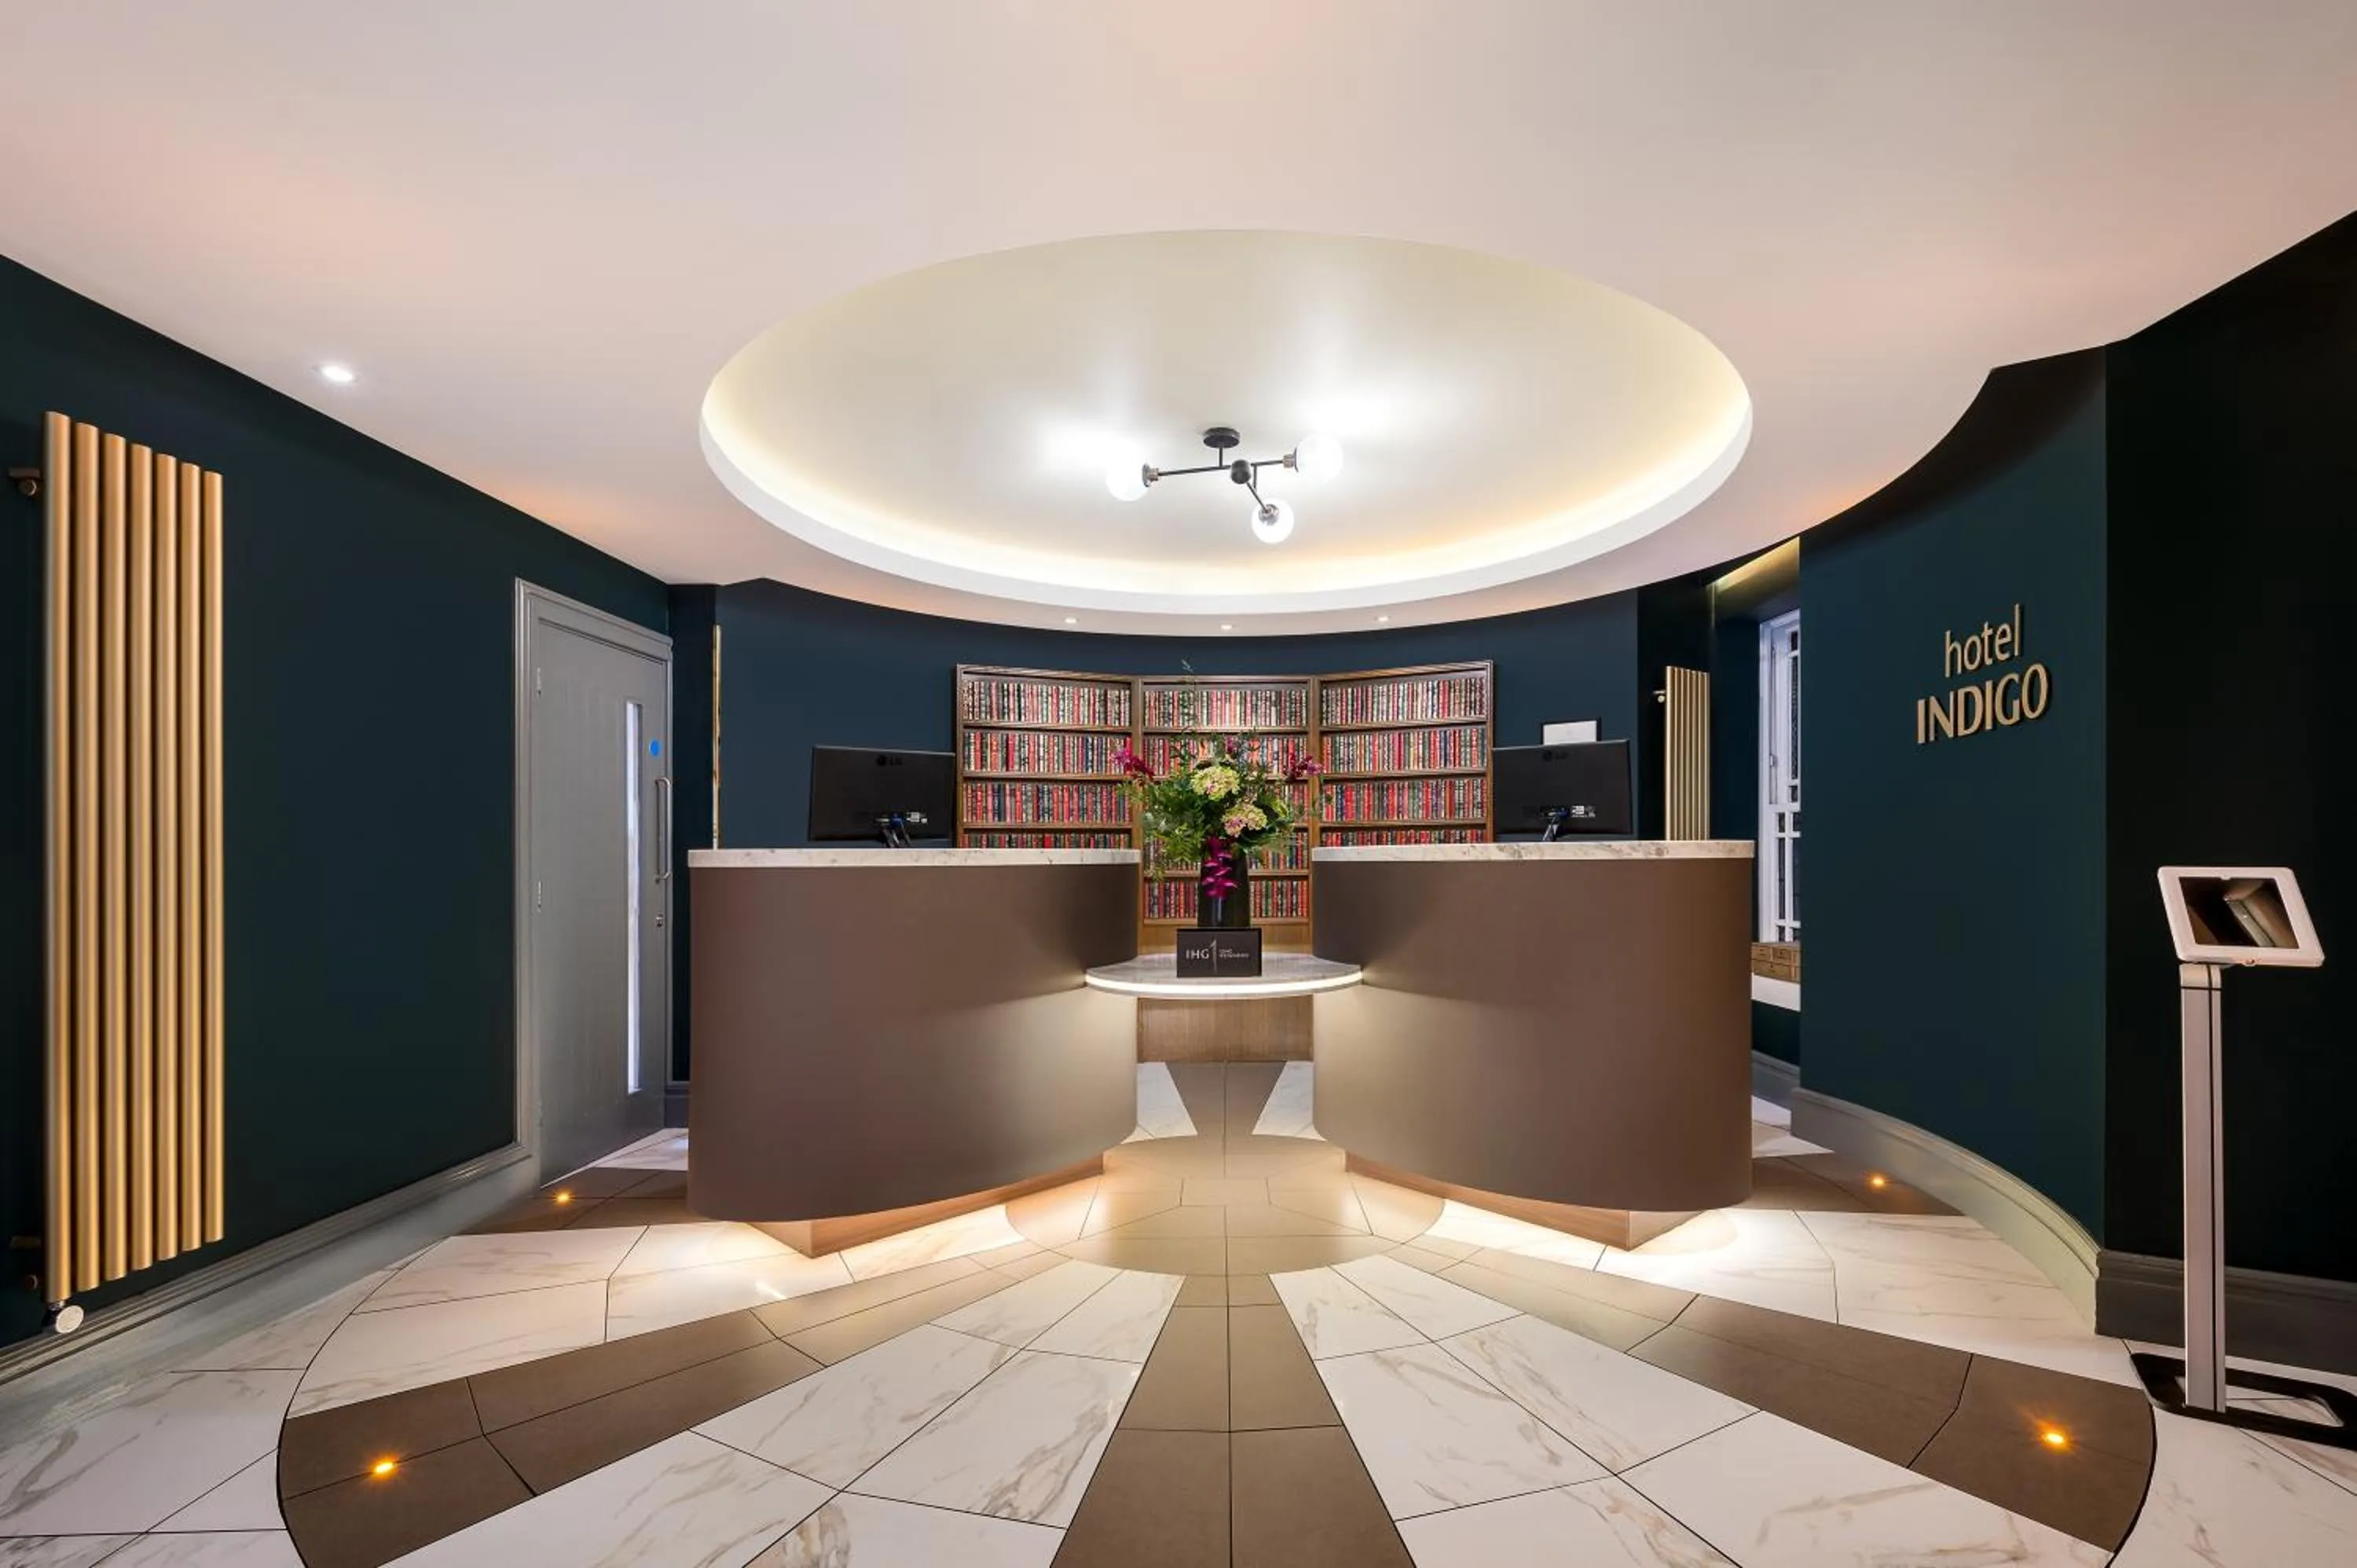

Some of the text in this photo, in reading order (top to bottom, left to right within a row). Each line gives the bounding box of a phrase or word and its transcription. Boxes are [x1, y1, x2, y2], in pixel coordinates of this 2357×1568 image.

[1945, 603, 2020, 678] hotel
[1917, 663, 2048, 744] INDIGO
[1186, 948, 1209, 959] IHG
